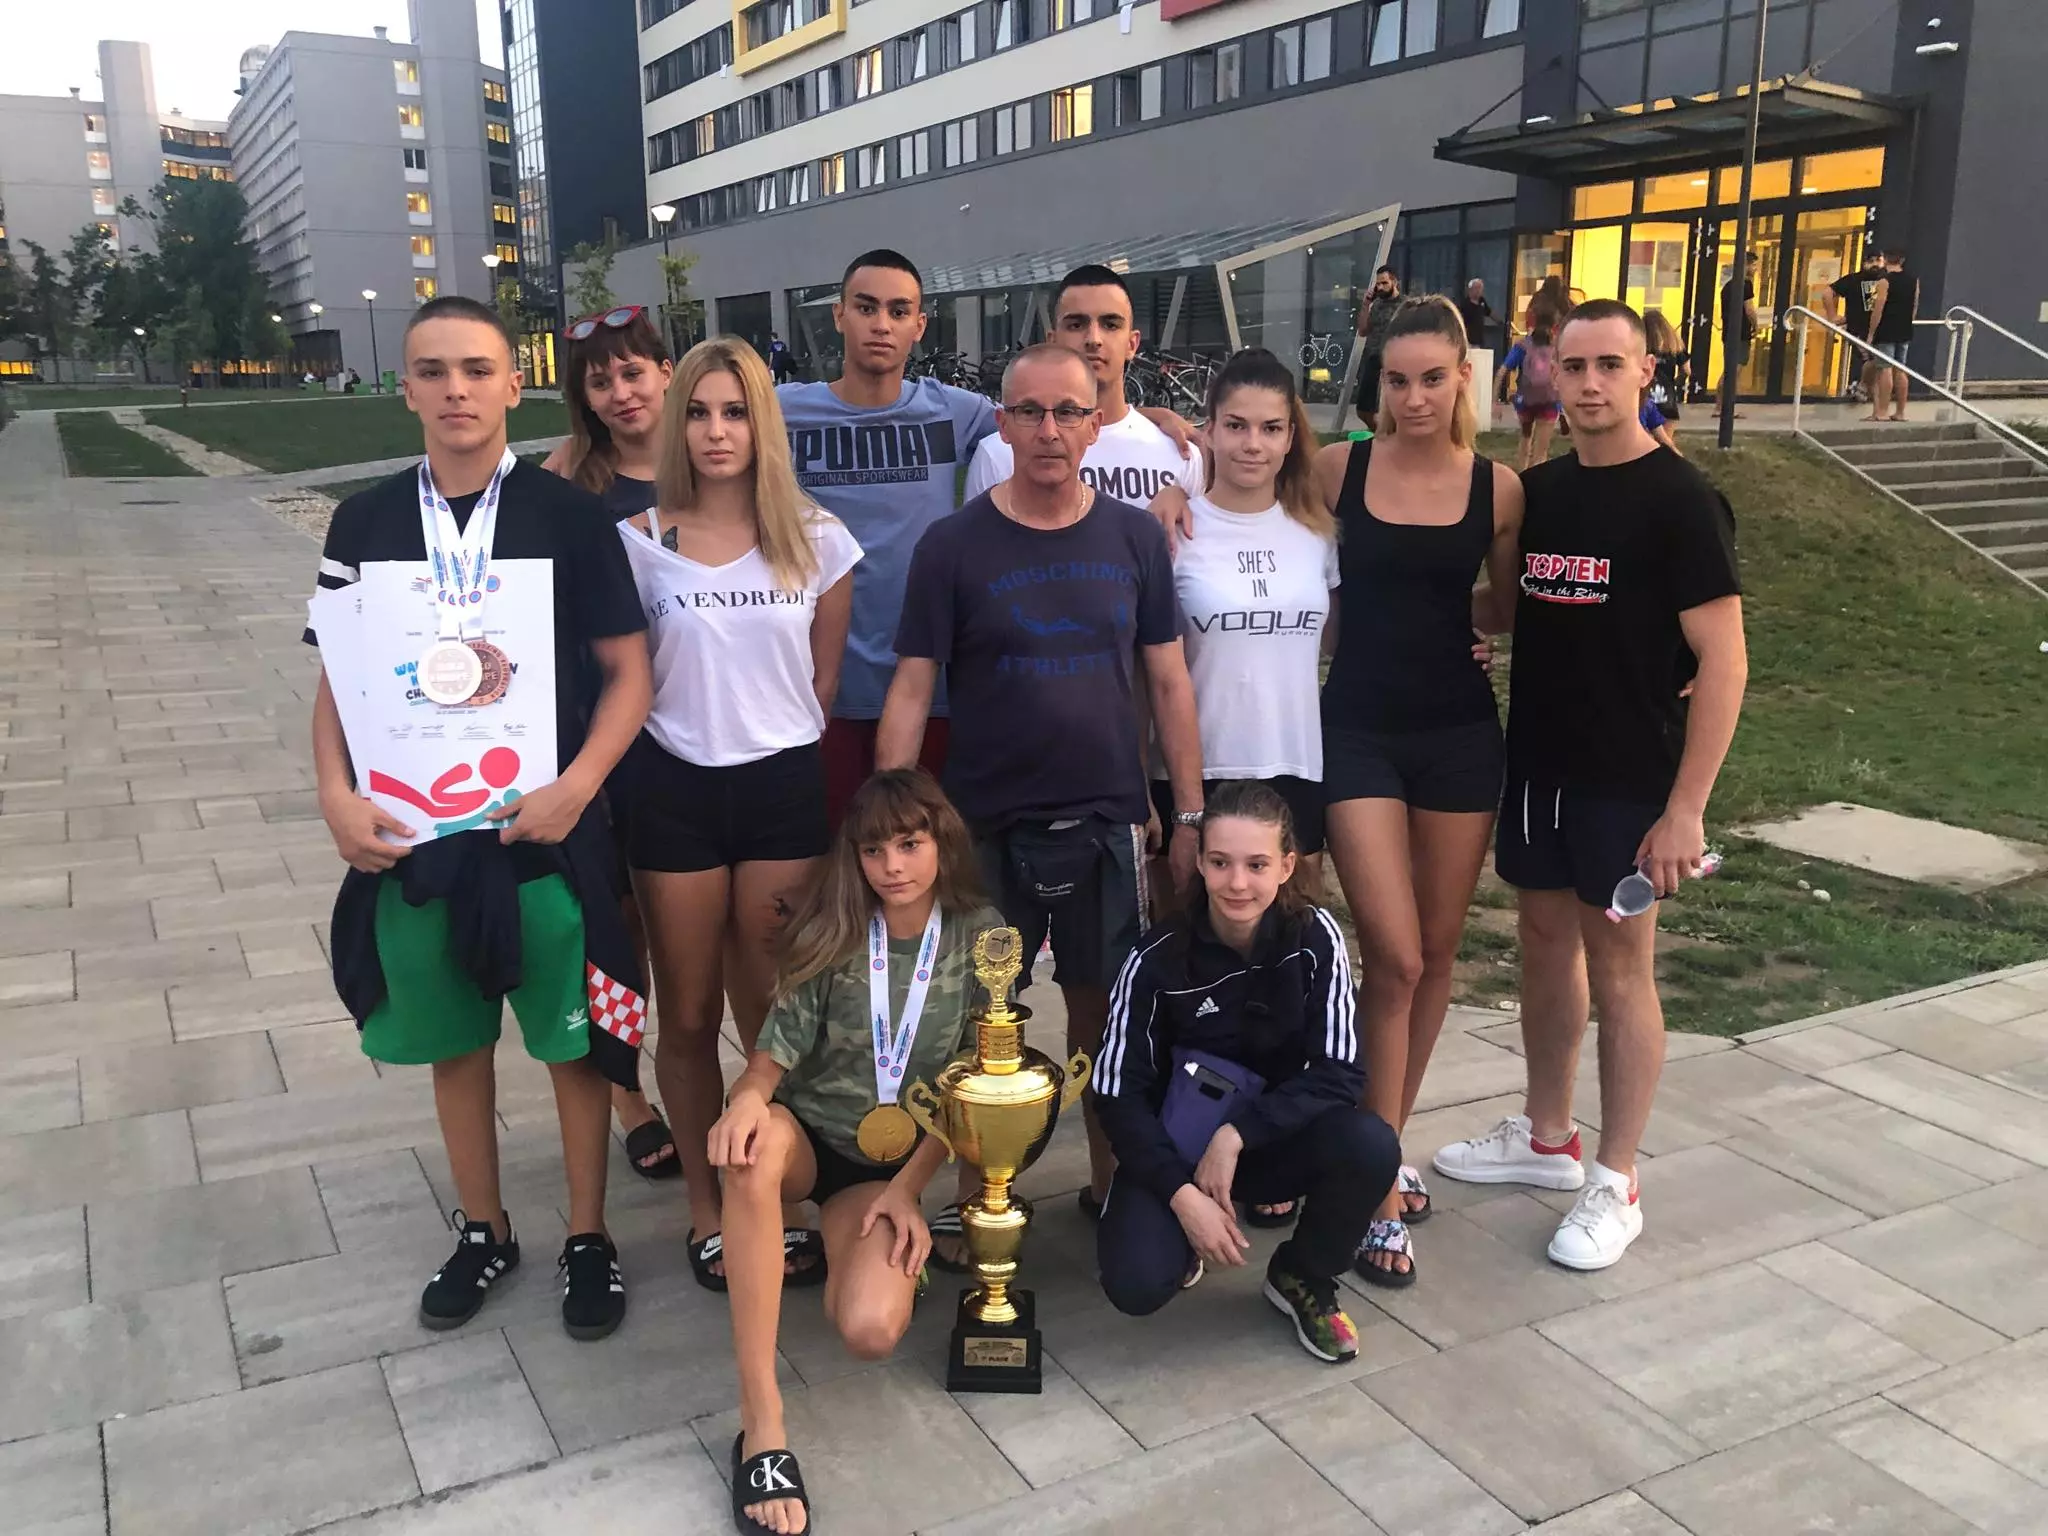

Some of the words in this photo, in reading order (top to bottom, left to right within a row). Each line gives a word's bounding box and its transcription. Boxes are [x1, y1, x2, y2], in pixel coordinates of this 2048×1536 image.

[796, 424, 928, 472] PUMA
[799, 473, 849, 486] ORIGINAL
[855, 470, 928, 484] SPORTSWEAR
[1237, 550, 1276, 574] SHE'S
[674, 588, 804, 609] VENDREDI
[1252, 579, 1268, 598] IN
[1556, 586, 1571, 597] the
[1573, 587, 1610, 604] Ring
[1191, 611, 1323, 636] VOGUE
